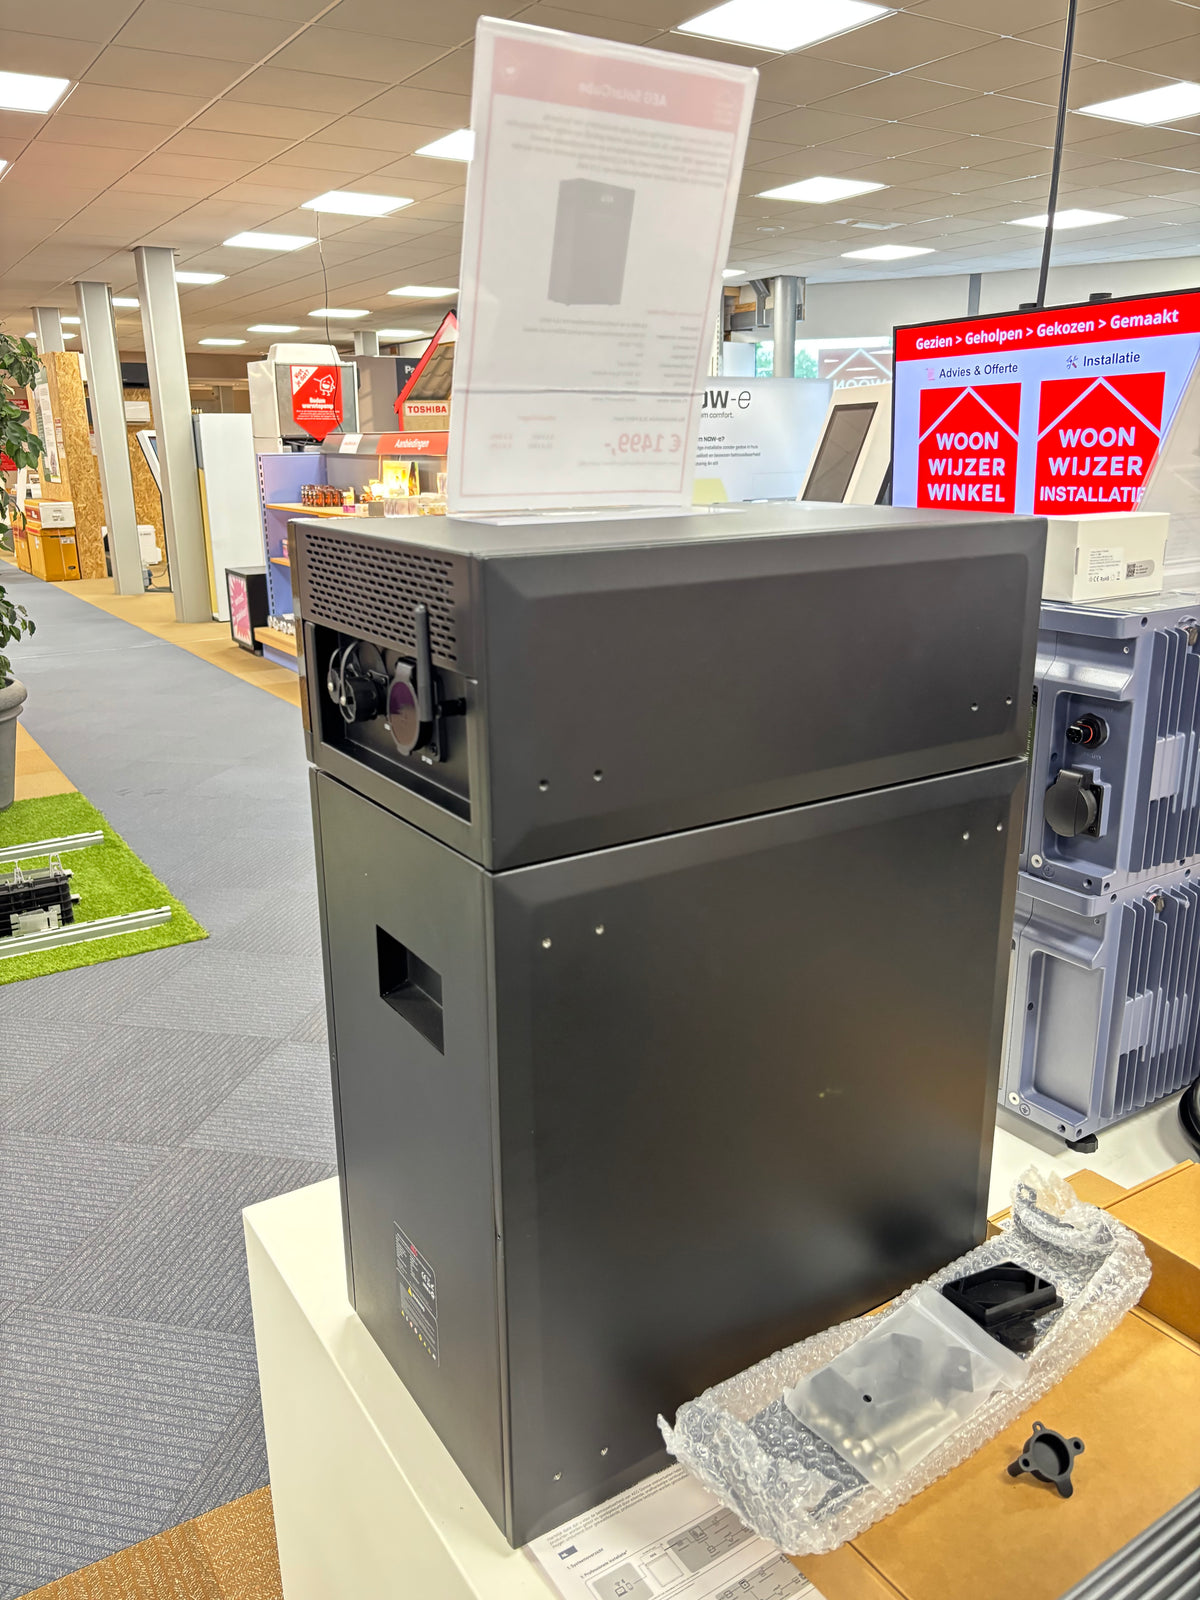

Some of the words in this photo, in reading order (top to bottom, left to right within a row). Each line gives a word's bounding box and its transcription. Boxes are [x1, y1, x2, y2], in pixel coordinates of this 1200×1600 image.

[916, 335, 953, 350] Gezien
[965, 328, 1023, 345] Geholpen
[1036, 321, 1095, 337] Gekozen
[1110, 308, 1179, 329] Gemaakt
[1083, 351, 1141, 367] Installatie
[939, 368, 971, 379] Advies
[974, 365, 981, 376] &
[984, 362, 1018, 375] Offerte
[407, 405, 447, 414] TOSHIBA
[936, 431, 999, 451] WOON
[1058, 426, 1136, 448] WOON
[928, 457, 1006, 476] WIJZER
[1048, 455, 1143, 476] WIJZER
[927, 483, 1006, 502] WINKEL
